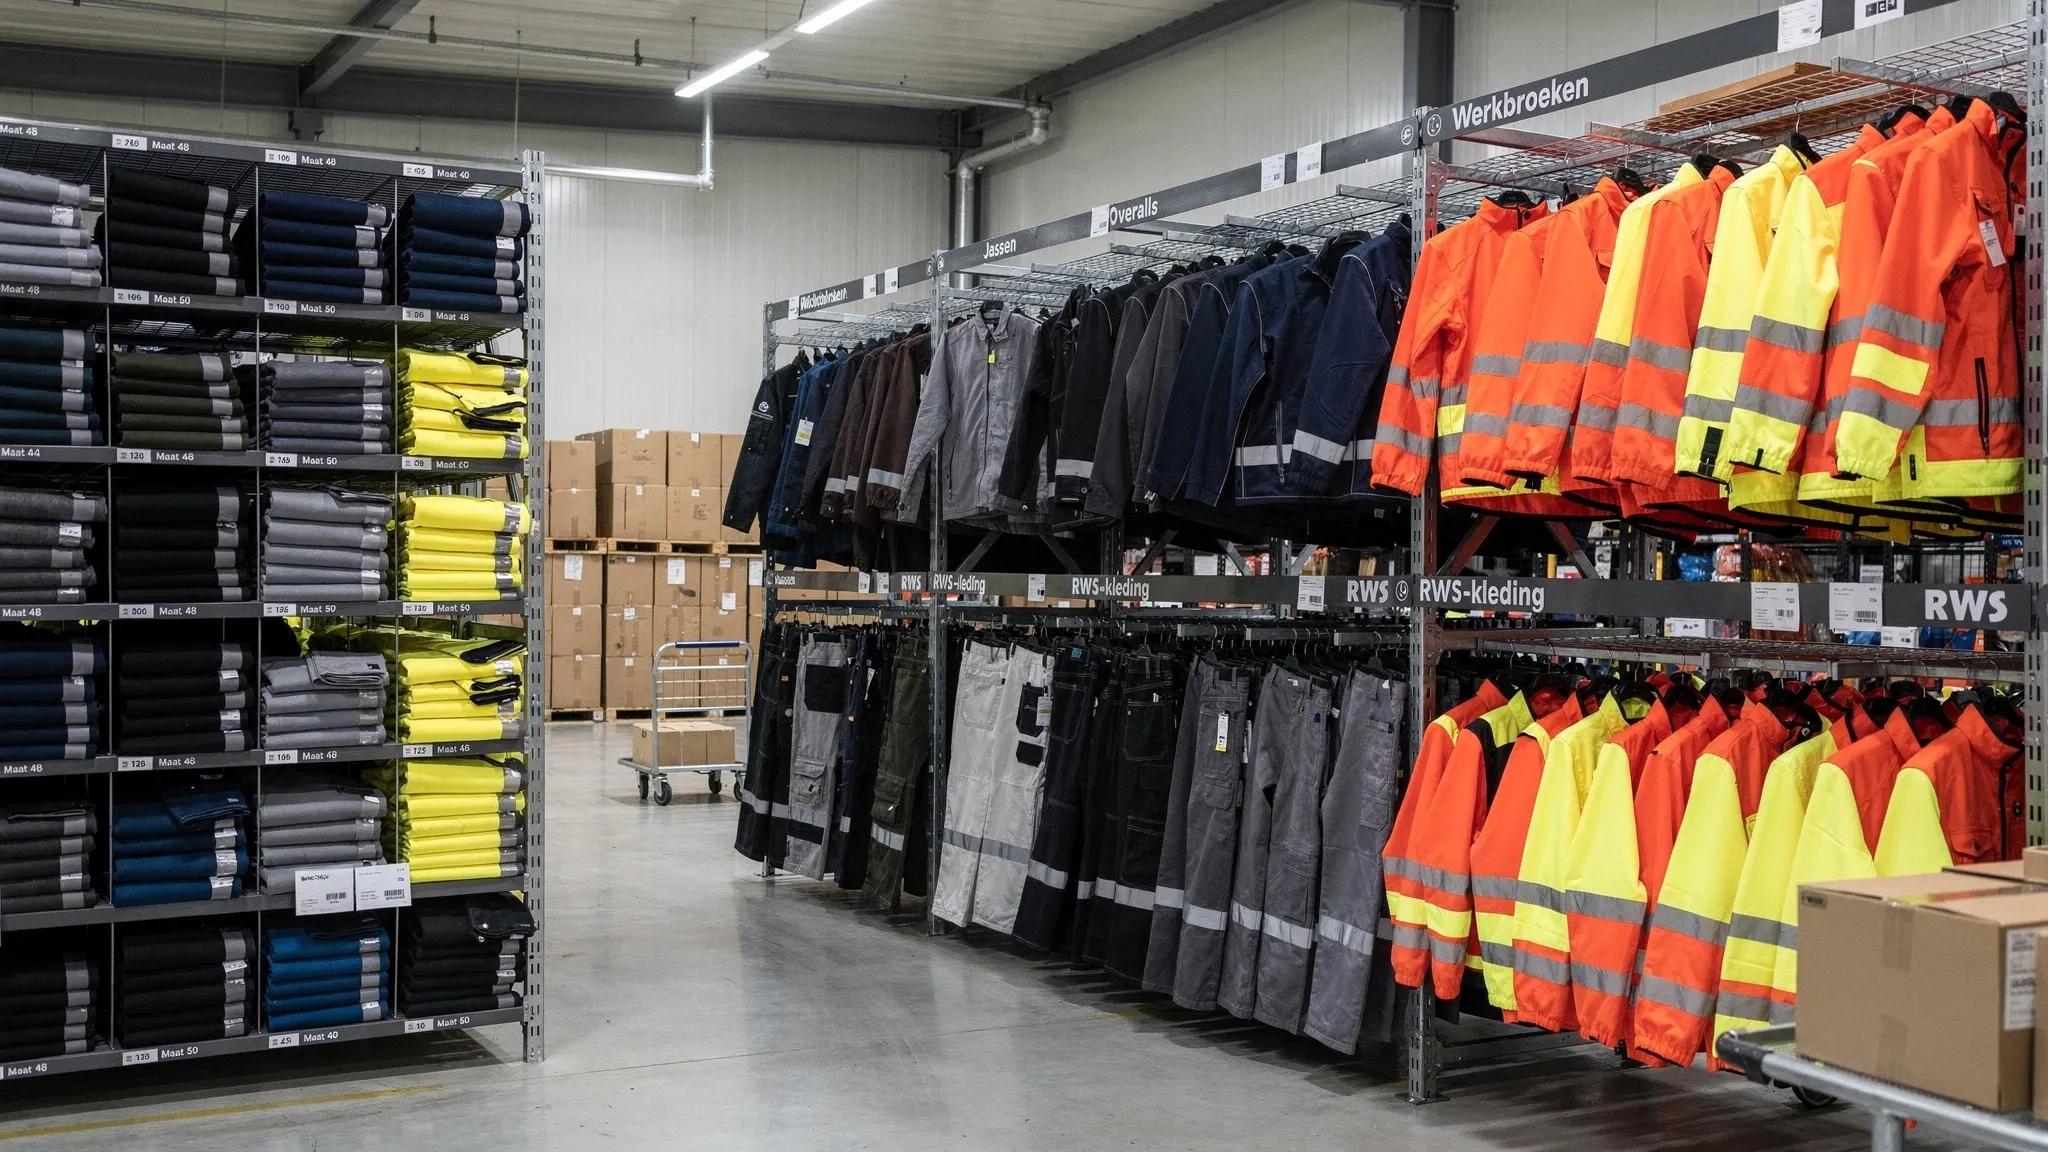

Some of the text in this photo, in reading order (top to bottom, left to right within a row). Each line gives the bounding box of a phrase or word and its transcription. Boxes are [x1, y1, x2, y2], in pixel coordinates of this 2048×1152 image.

[1452, 76, 1589, 131] Werkbroeken
[25, 126, 38, 136] 48
[152, 140, 190, 152] Maat 48
[325, 157, 336, 166] 48
[1110, 197, 1158, 226] Overalls
[983, 238, 1017, 259] Jassen
[300, 303, 336, 314] Maat 50
[458, 313, 469, 321] 48
[1, 447, 41, 457] Maat 44
[901, 574, 922, 591] RWS
[1072, 577, 1150, 601] RWS-kleding
[1347, 579, 1389, 603] RWS
[1419, 579, 1545, 612] RWS-kleding
[159, 606, 197, 616] Maat 48
[325, 604, 337, 613] 50
[1924, 588, 2008, 623] RWS
[2, 607, 42, 617] Maat 48
[159, 757, 182, 767] Maat
[4, 763, 43, 774] Maat 48
[326, 1031, 339, 1040] 40
[161, 1046, 199, 1059] Maat 50
[7, 1062, 48, 1077] Maat 48
